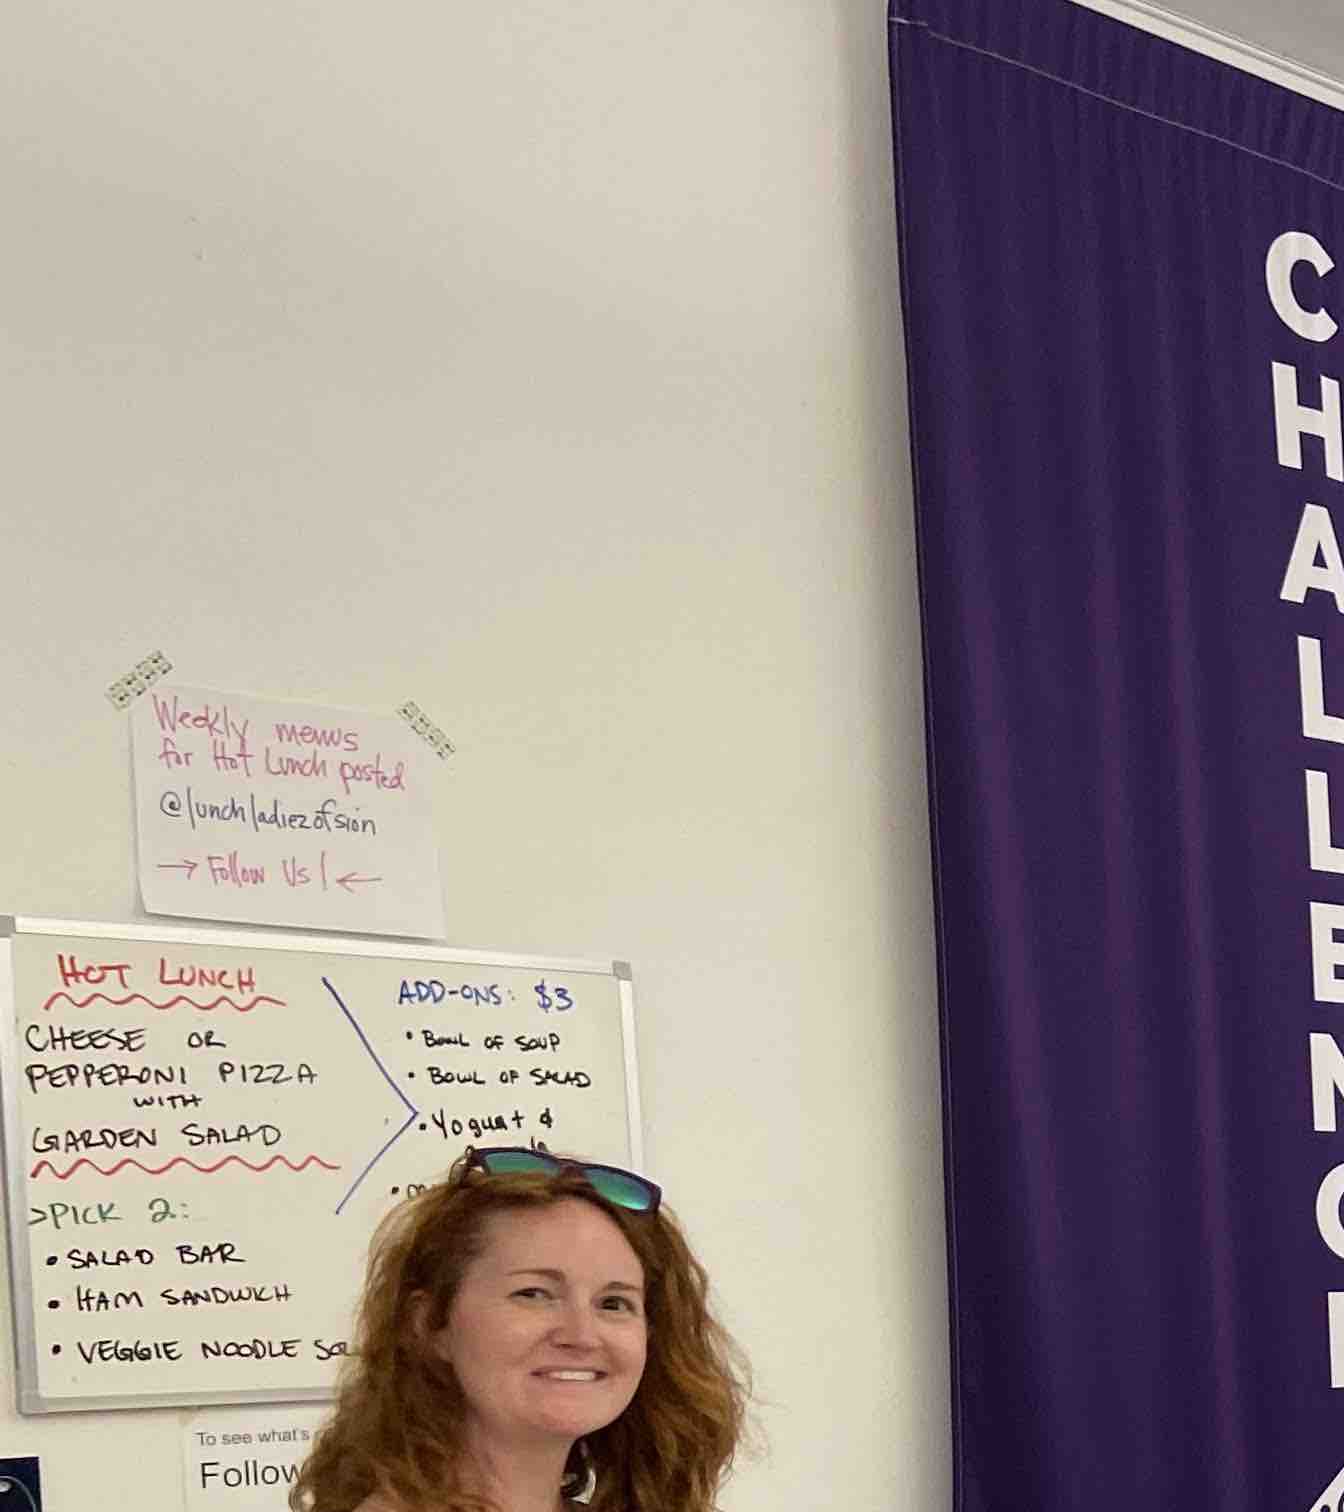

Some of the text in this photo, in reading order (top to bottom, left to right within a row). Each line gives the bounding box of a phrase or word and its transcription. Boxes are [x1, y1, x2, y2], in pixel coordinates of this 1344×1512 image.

[151, 694, 361, 753] Weekly menus
[158, 737, 407, 795] for Hot Lunch posted
[207, 850, 266, 890] Follow
[57, 953, 257, 995] HOT LUNCH
[533, 978, 575, 1015] $3
[24, 1024, 227, 1053] CHEESE OR
[421, 1028, 562, 1053] BOWL OF SOUP
[24, 1061, 319, 1095] PEPPERONI PIZZA
[427, 1065, 592, 1088] BOWL OF SALAD
[131, 1094, 204, 1110] WITH
[31, 1122, 282, 1155] GARDEN SALAD
[66, 1242, 247, 1270] SALAD BAR
[75, 1284, 145, 1313] HAM
[75, 1339, 184, 1365] VEGGIE
[200, 1338, 303, 1360] NOODLE
[198, 1426, 311, 1447] To see what's
[198, 1459, 305, 1489] Follow
